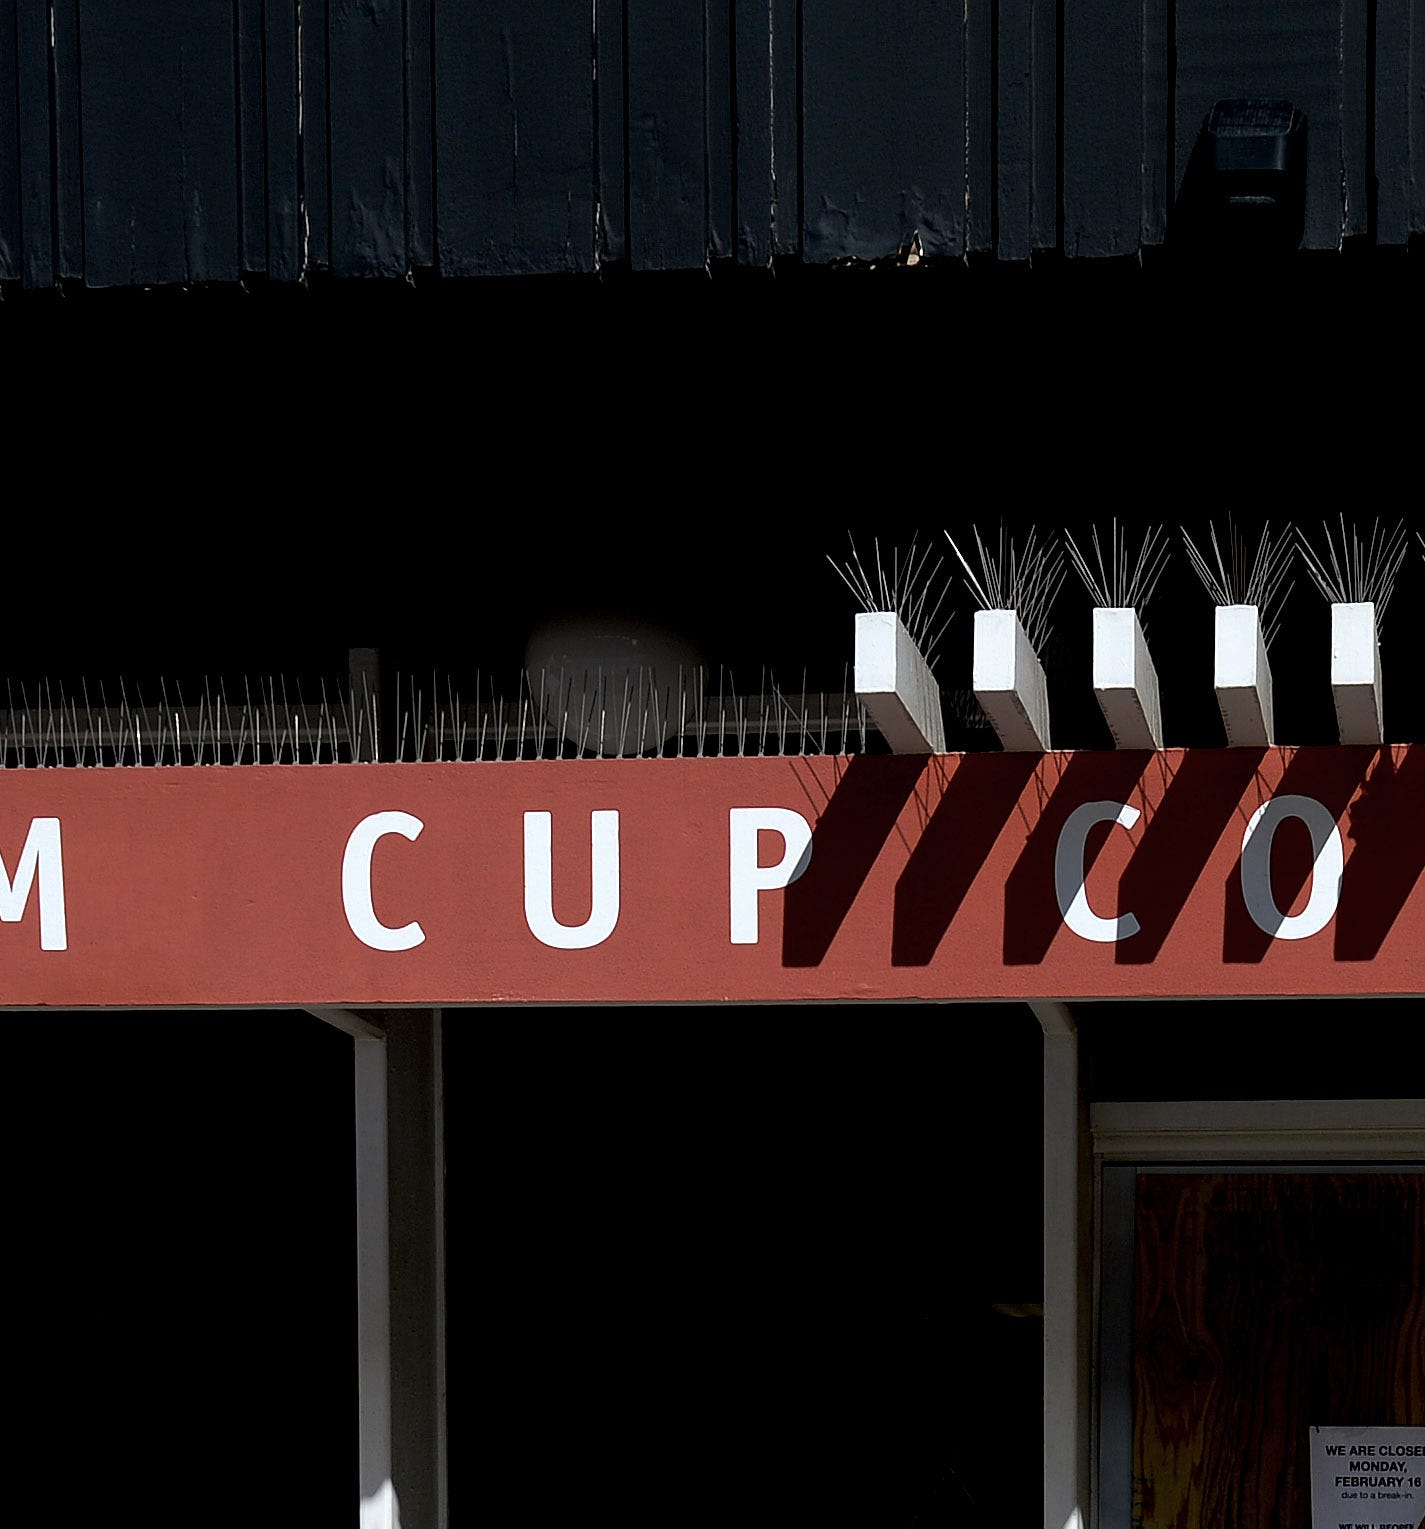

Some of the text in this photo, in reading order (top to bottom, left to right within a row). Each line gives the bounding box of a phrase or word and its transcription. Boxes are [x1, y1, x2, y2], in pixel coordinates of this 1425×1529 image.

[341, 804, 818, 954] CUP
[1326, 1445, 1346, 1456] WE
[1349, 1445, 1376, 1456] ARE
[1349, 1461, 1407, 1473] MONDAY,
[1335, 1477, 1422, 1488] FEBRUARY 16
